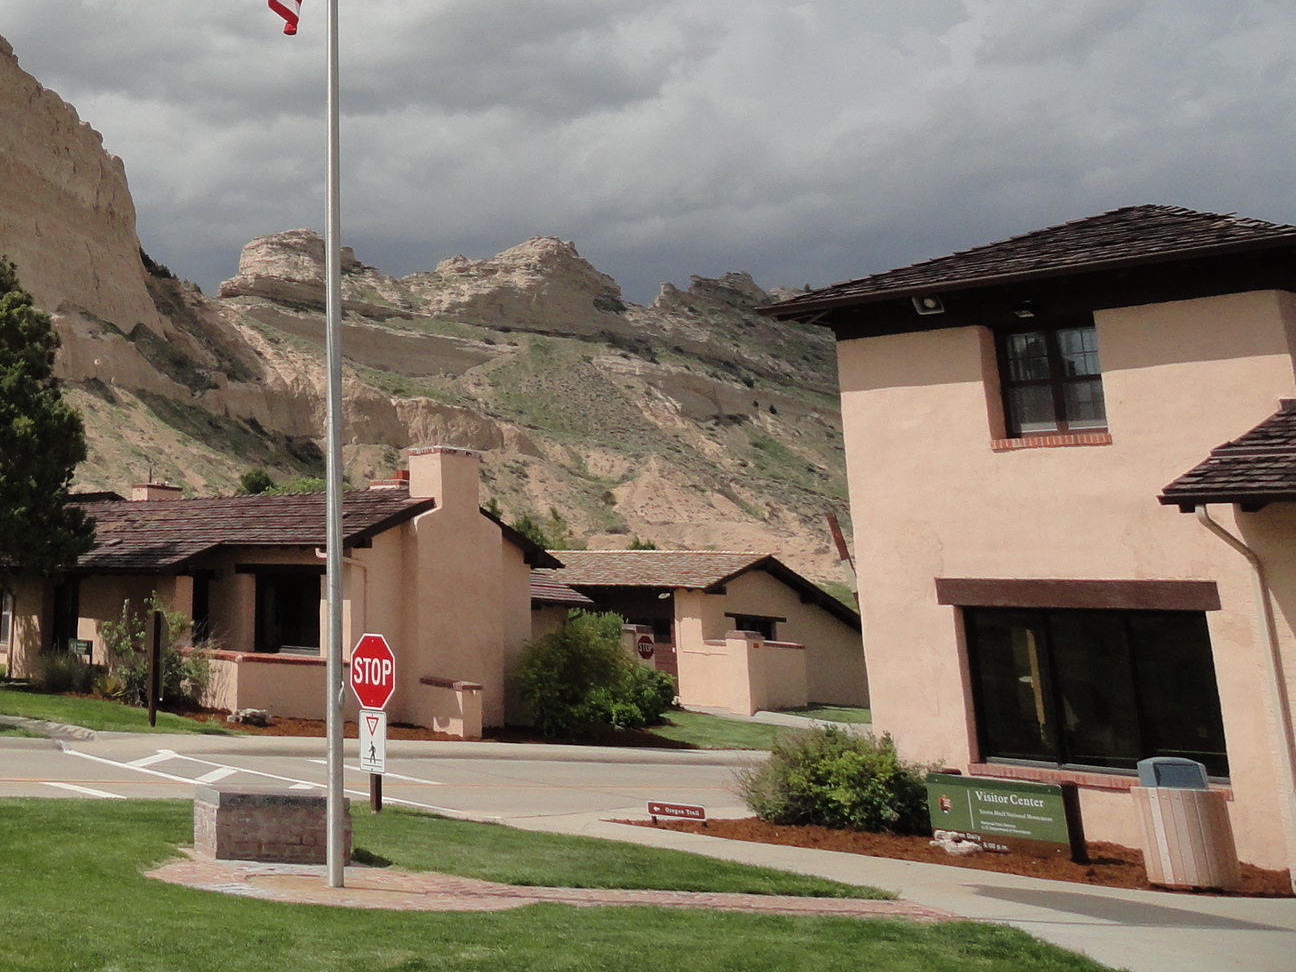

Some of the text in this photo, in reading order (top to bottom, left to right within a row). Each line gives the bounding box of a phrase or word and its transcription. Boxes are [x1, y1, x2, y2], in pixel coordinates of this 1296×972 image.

[639, 643, 653, 652] STOP
[354, 657, 391, 686] STOP
[975, 791, 1044, 808] Visitor Center
